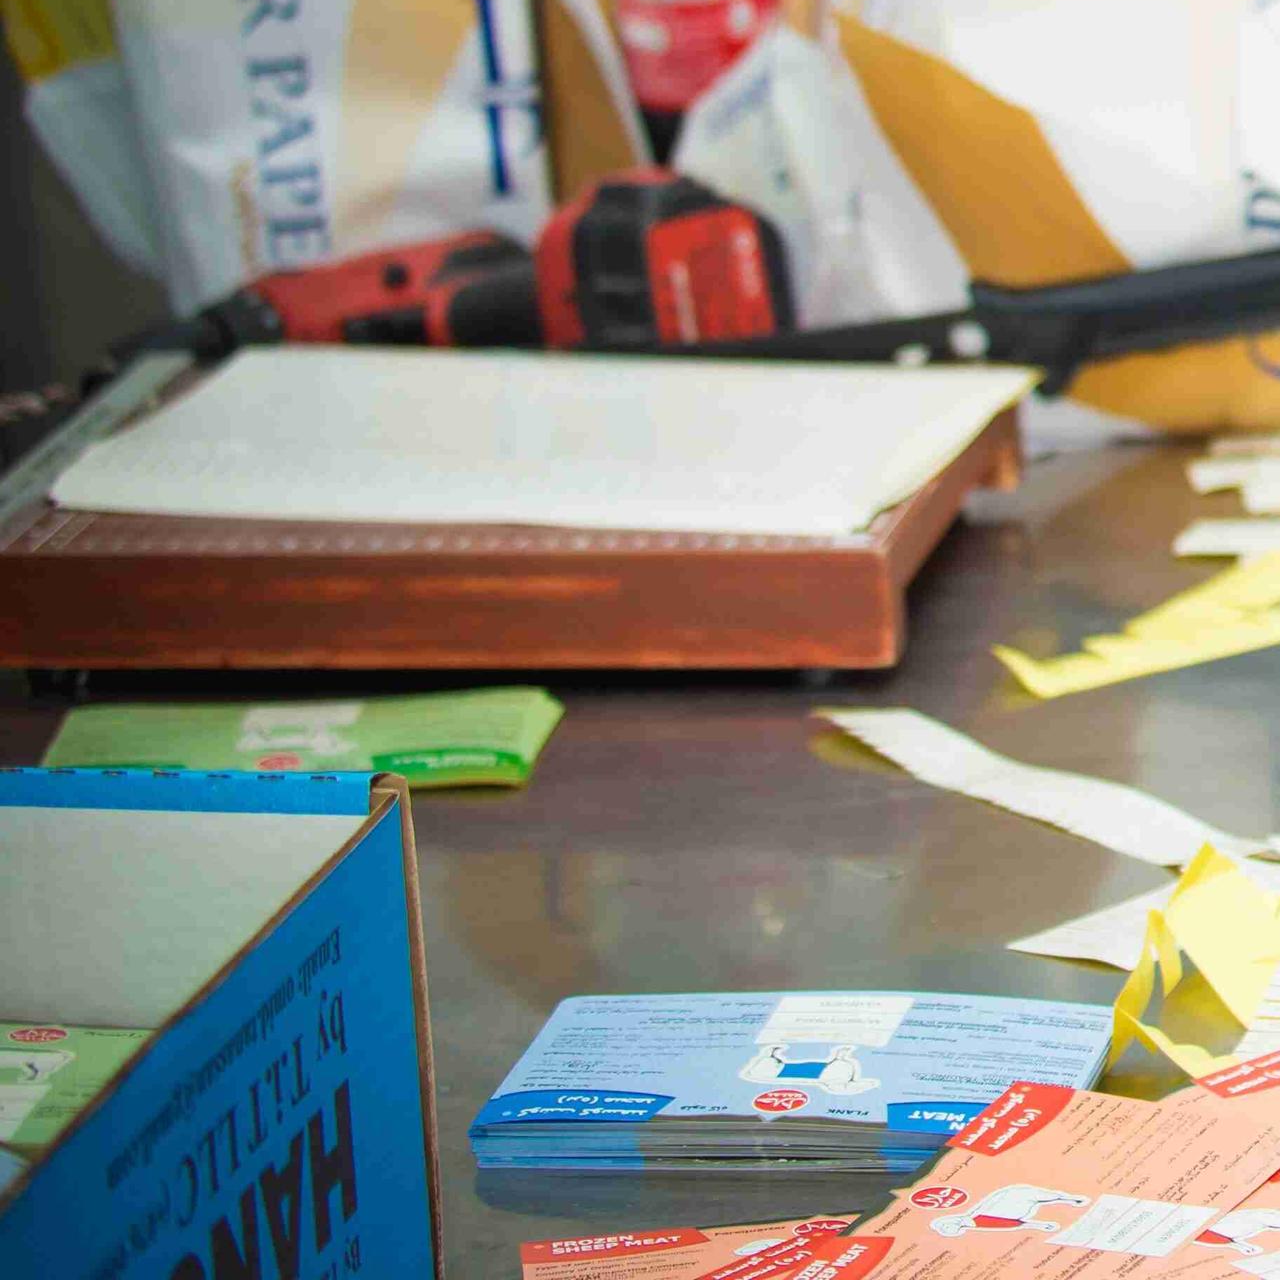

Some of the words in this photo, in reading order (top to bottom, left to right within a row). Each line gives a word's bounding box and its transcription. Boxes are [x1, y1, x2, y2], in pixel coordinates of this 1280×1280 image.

[316, 990, 348, 1062] by
[828, 1107, 870, 1117] FLANK
[908, 1109, 966, 1122] MEAT
[170, 1077, 359, 1280] HAN
[551, 1242, 620, 1256] SHEEP
[623, 1235, 682, 1248] MEAT
[552, 1234, 635, 1249] FROZEN
[831, 1243, 869, 1267] MEAT
